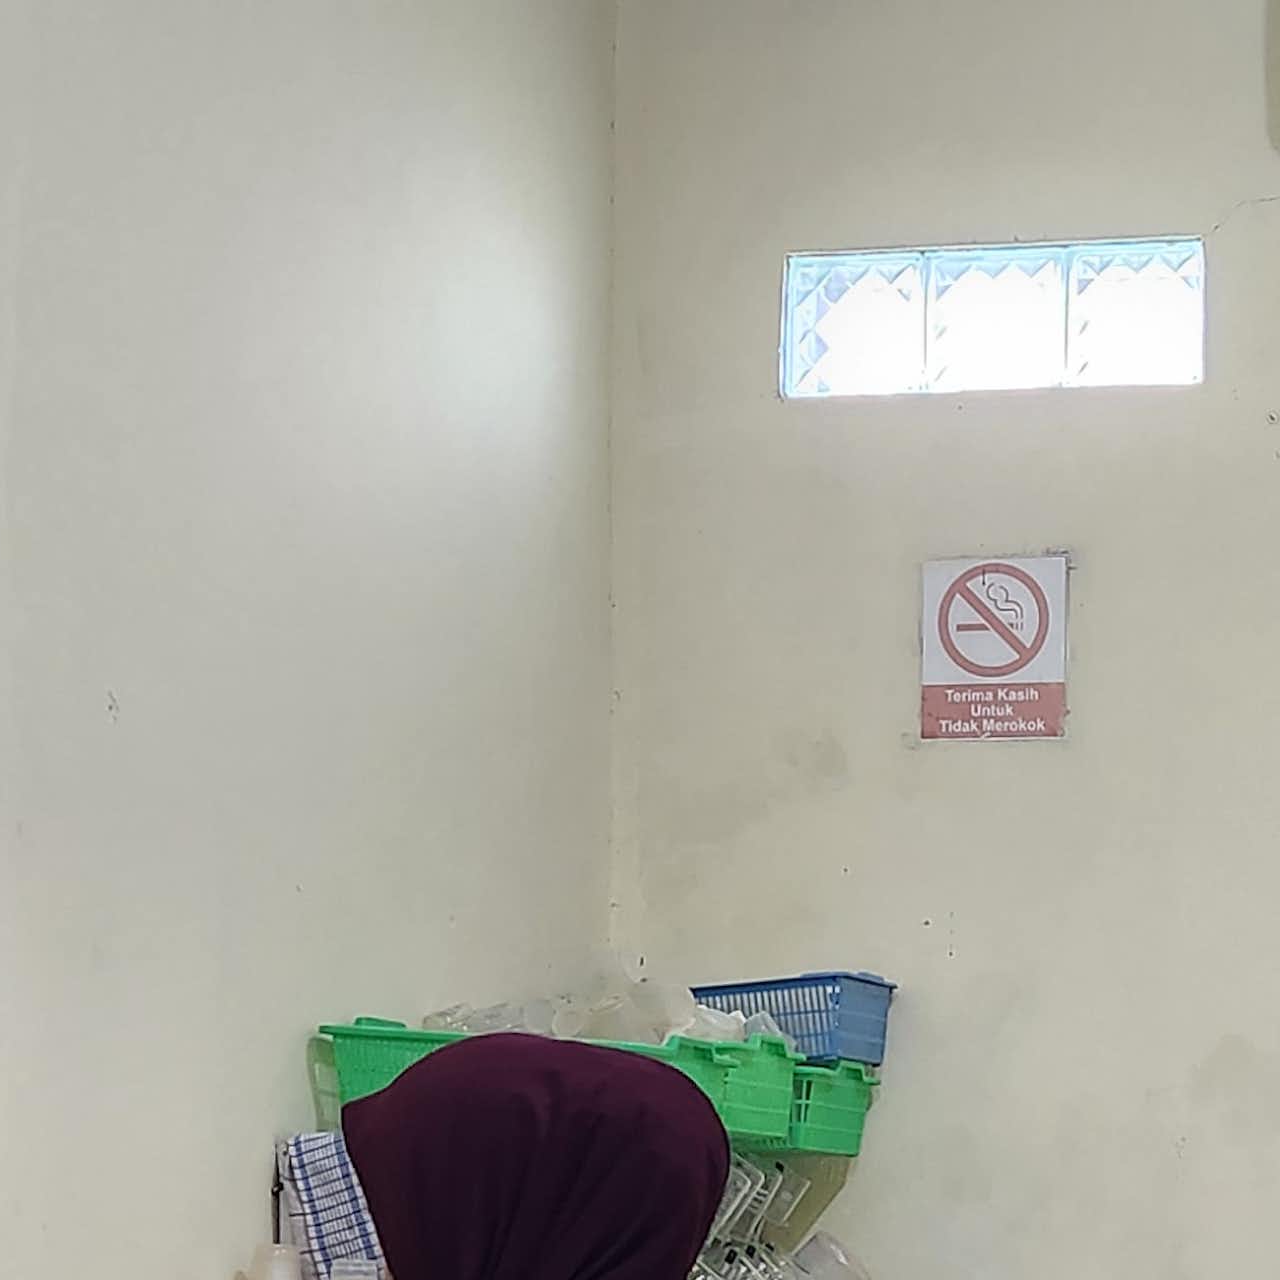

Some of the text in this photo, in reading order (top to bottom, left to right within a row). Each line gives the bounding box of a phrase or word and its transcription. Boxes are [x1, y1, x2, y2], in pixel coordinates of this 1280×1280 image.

[945, 687, 1039, 702] Terima Kasih
[971, 703, 1013, 717] Untuk
[939, 718, 1045, 733] Tidak Merokok
